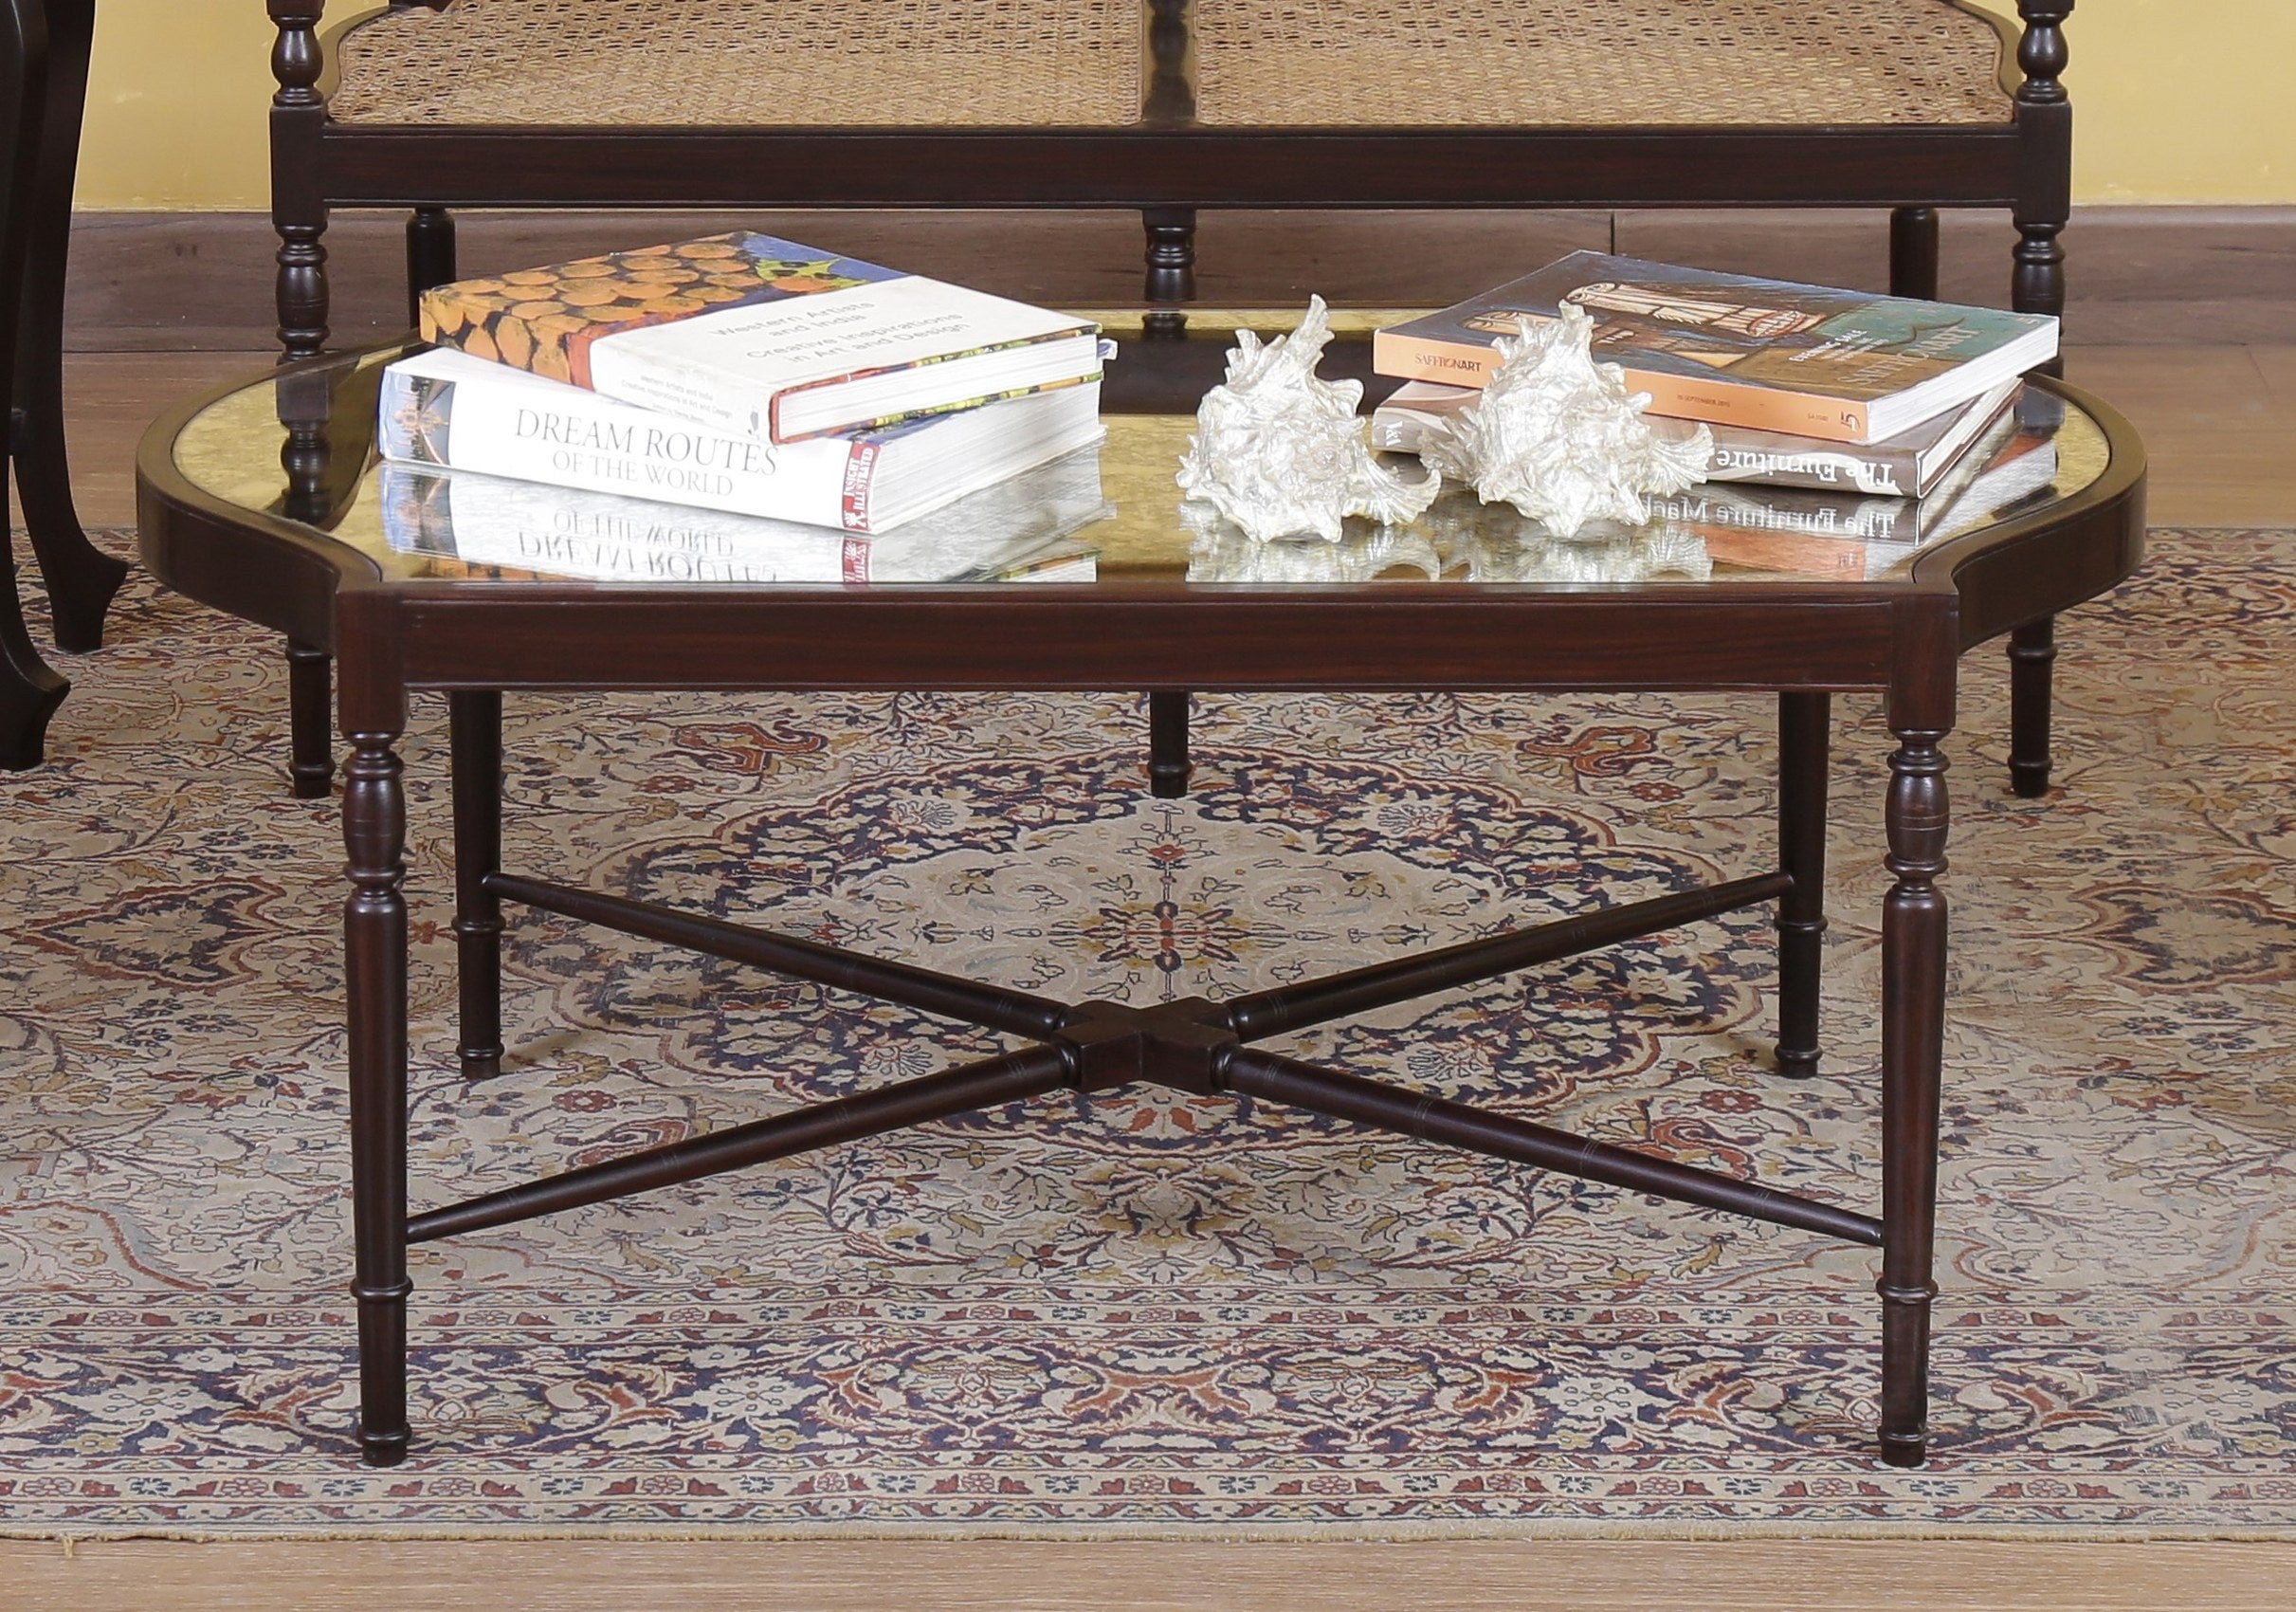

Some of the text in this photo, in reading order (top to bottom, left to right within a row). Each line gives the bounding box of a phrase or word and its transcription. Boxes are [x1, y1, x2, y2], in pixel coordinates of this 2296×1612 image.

[713, 302, 875, 336] Western Artists
[746, 312, 963, 358] Creative Inspirations
[768, 313, 867, 337] and India
[789, 322, 972, 364] in Art and Design
[516, 409, 634, 453] DREAM
[645, 429, 778, 476] ROUTES
[553, 449, 733, 496] OF THE WORLD
[844, 458, 860, 497] INSIGHT
[853, 448, 874, 510] ILLUSTRATED
[1716, 449, 1896, 487] The Furniture
